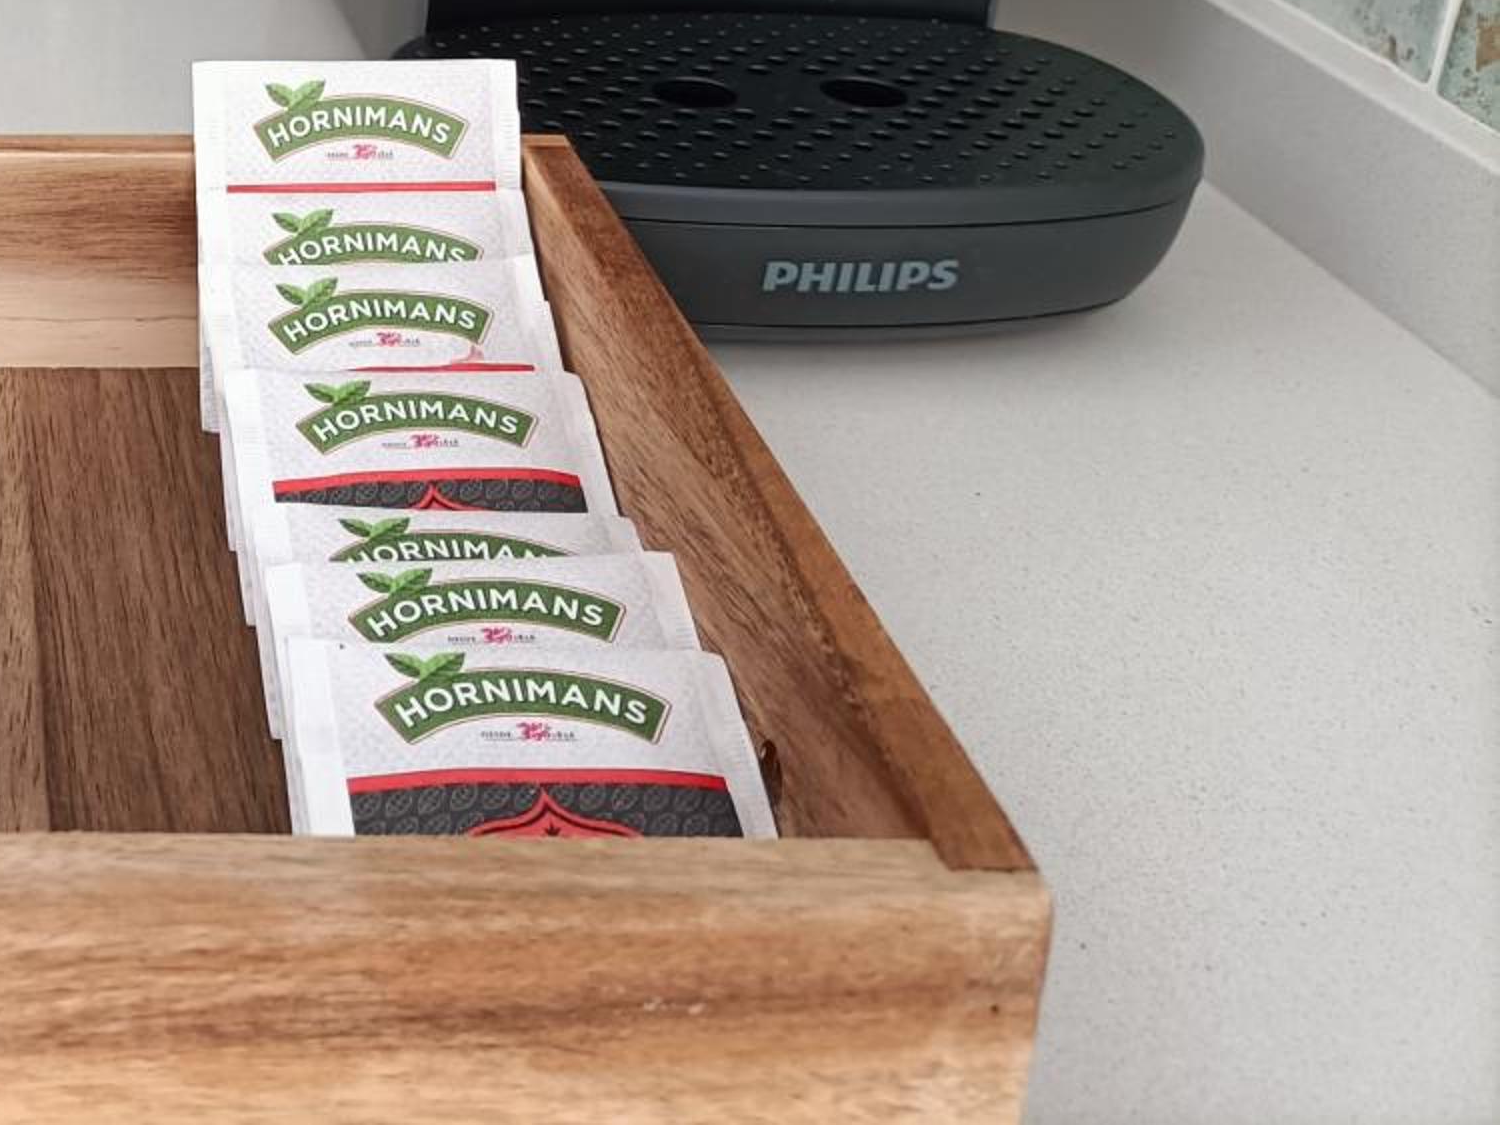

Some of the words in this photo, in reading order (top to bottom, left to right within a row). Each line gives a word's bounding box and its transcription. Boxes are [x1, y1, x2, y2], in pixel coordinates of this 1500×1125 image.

[266, 106, 451, 148] HORNIMANS
[278, 231, 466, 265] HORNIMANS
[762, 259, 961, 293] PHILIPS
[282, 299, 477, 343] HORNIMANS
[313, 400, 519, 443] HORNIMANS
[366, 588, 604, 641] HORNIMANS
[394, 676, 647, 729] HORNIMANS
